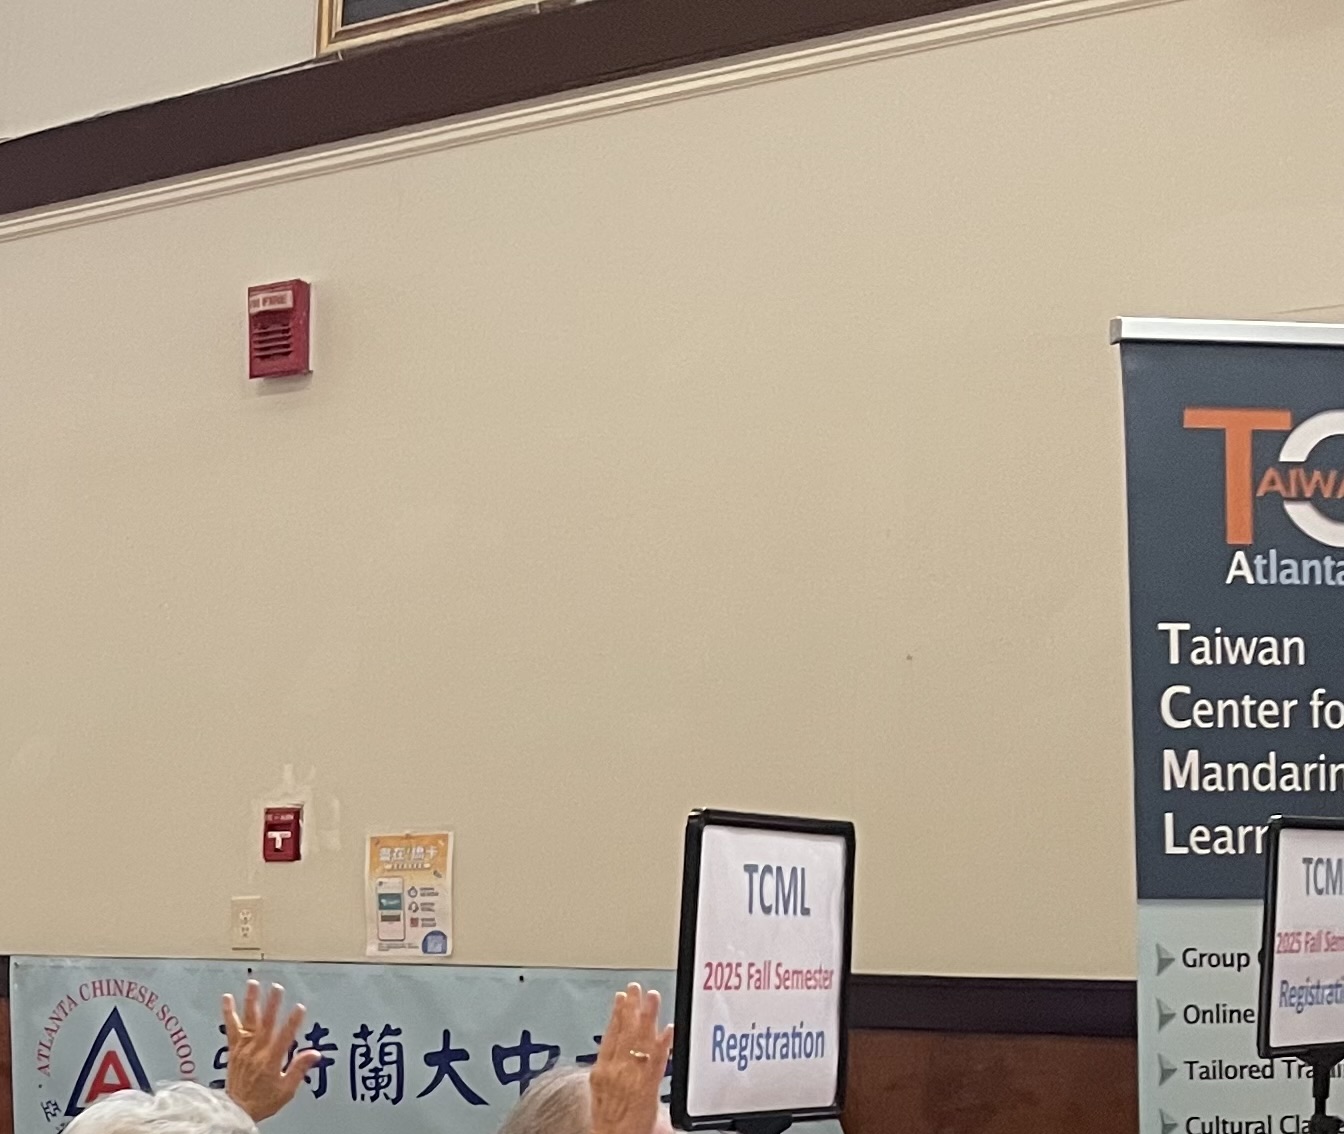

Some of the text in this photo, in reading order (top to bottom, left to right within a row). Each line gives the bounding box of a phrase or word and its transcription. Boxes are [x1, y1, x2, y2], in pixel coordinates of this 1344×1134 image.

[1158, 622, 1306, 667] Taiwan
[1160, 685, 1298, 730] Center
[743, 863, 811, 917] TCML
[1182, 946, 1251, 973] Group
[1276, 931, 1302, 954] 2025
[1305, 931, 1322, 953] Fall
[703, 960, 834, 991] 2025 Fall Semester
[36, 978, 198, 1081] ATLANTA CHINESE SCHOO
[1183, 1004, 1257, 1026] Online
[711, 1020, 825, 1072] Registration
[1184, 1059, 1275, 1081] Tailored
